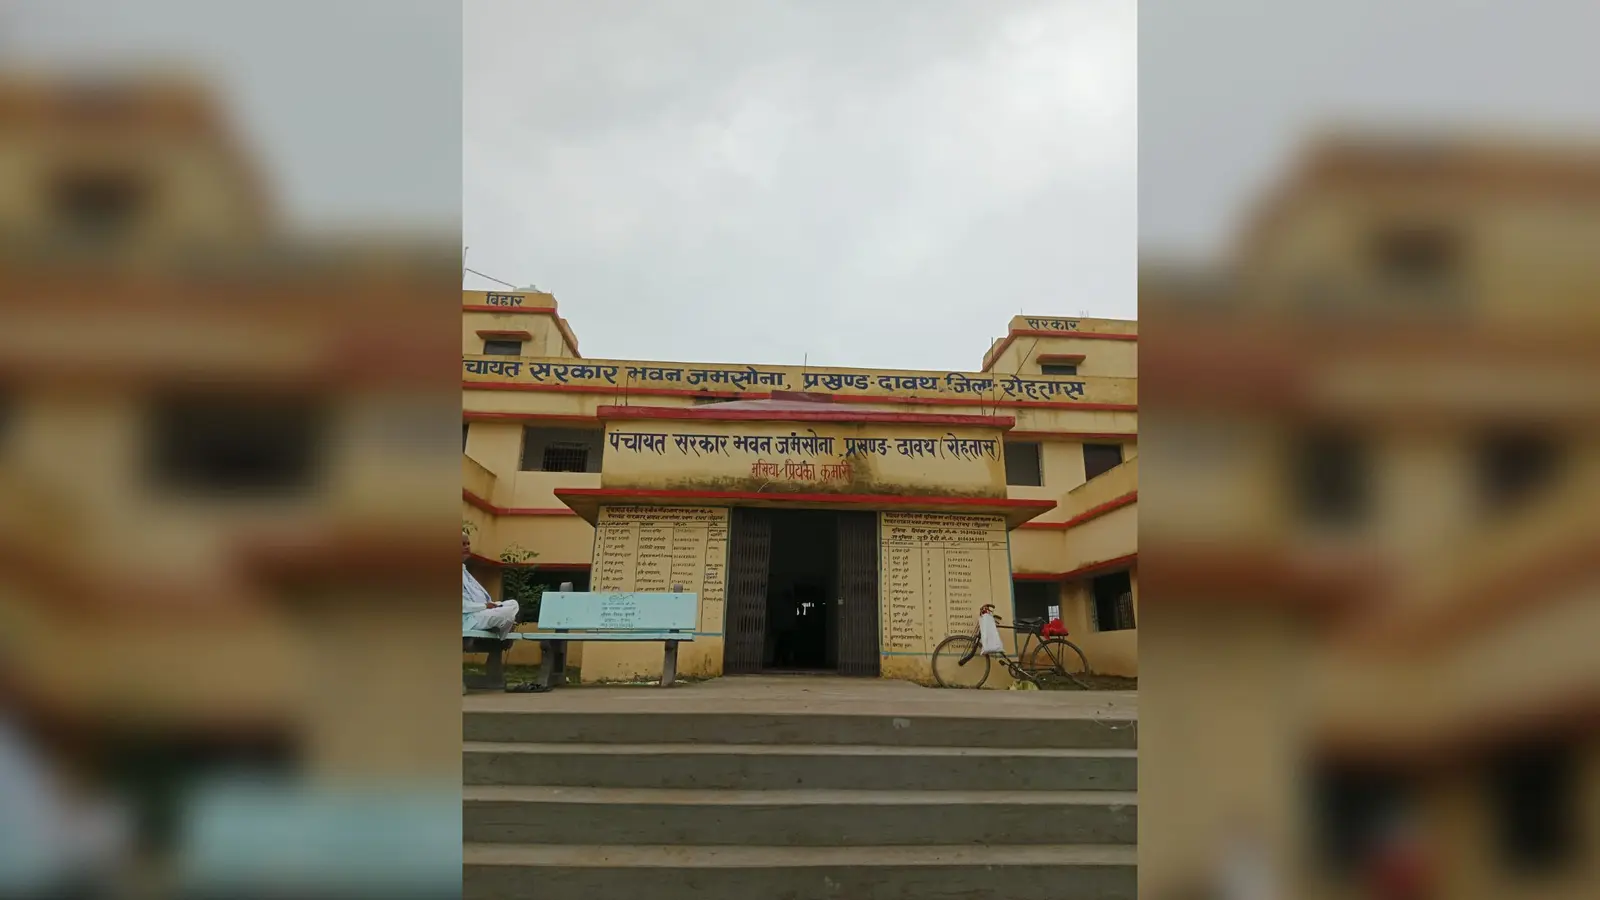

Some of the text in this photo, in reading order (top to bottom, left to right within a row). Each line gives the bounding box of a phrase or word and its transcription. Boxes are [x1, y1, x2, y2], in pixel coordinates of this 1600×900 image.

[486, 291, 525, 306] बिहार
[1024, 317, 1081, 331] सरकार
[463, 360, 523, 378] चायत
[529, 362, 619, 384] सरकार
[625, 366, 684, 382] भवन
[608, 429, 668, 455] पंचायत
[672, 433, 730, 457] सरकार
[733, 435, 773, 454] भवन
[939, 432, 1001, 461] (रोहतास)
